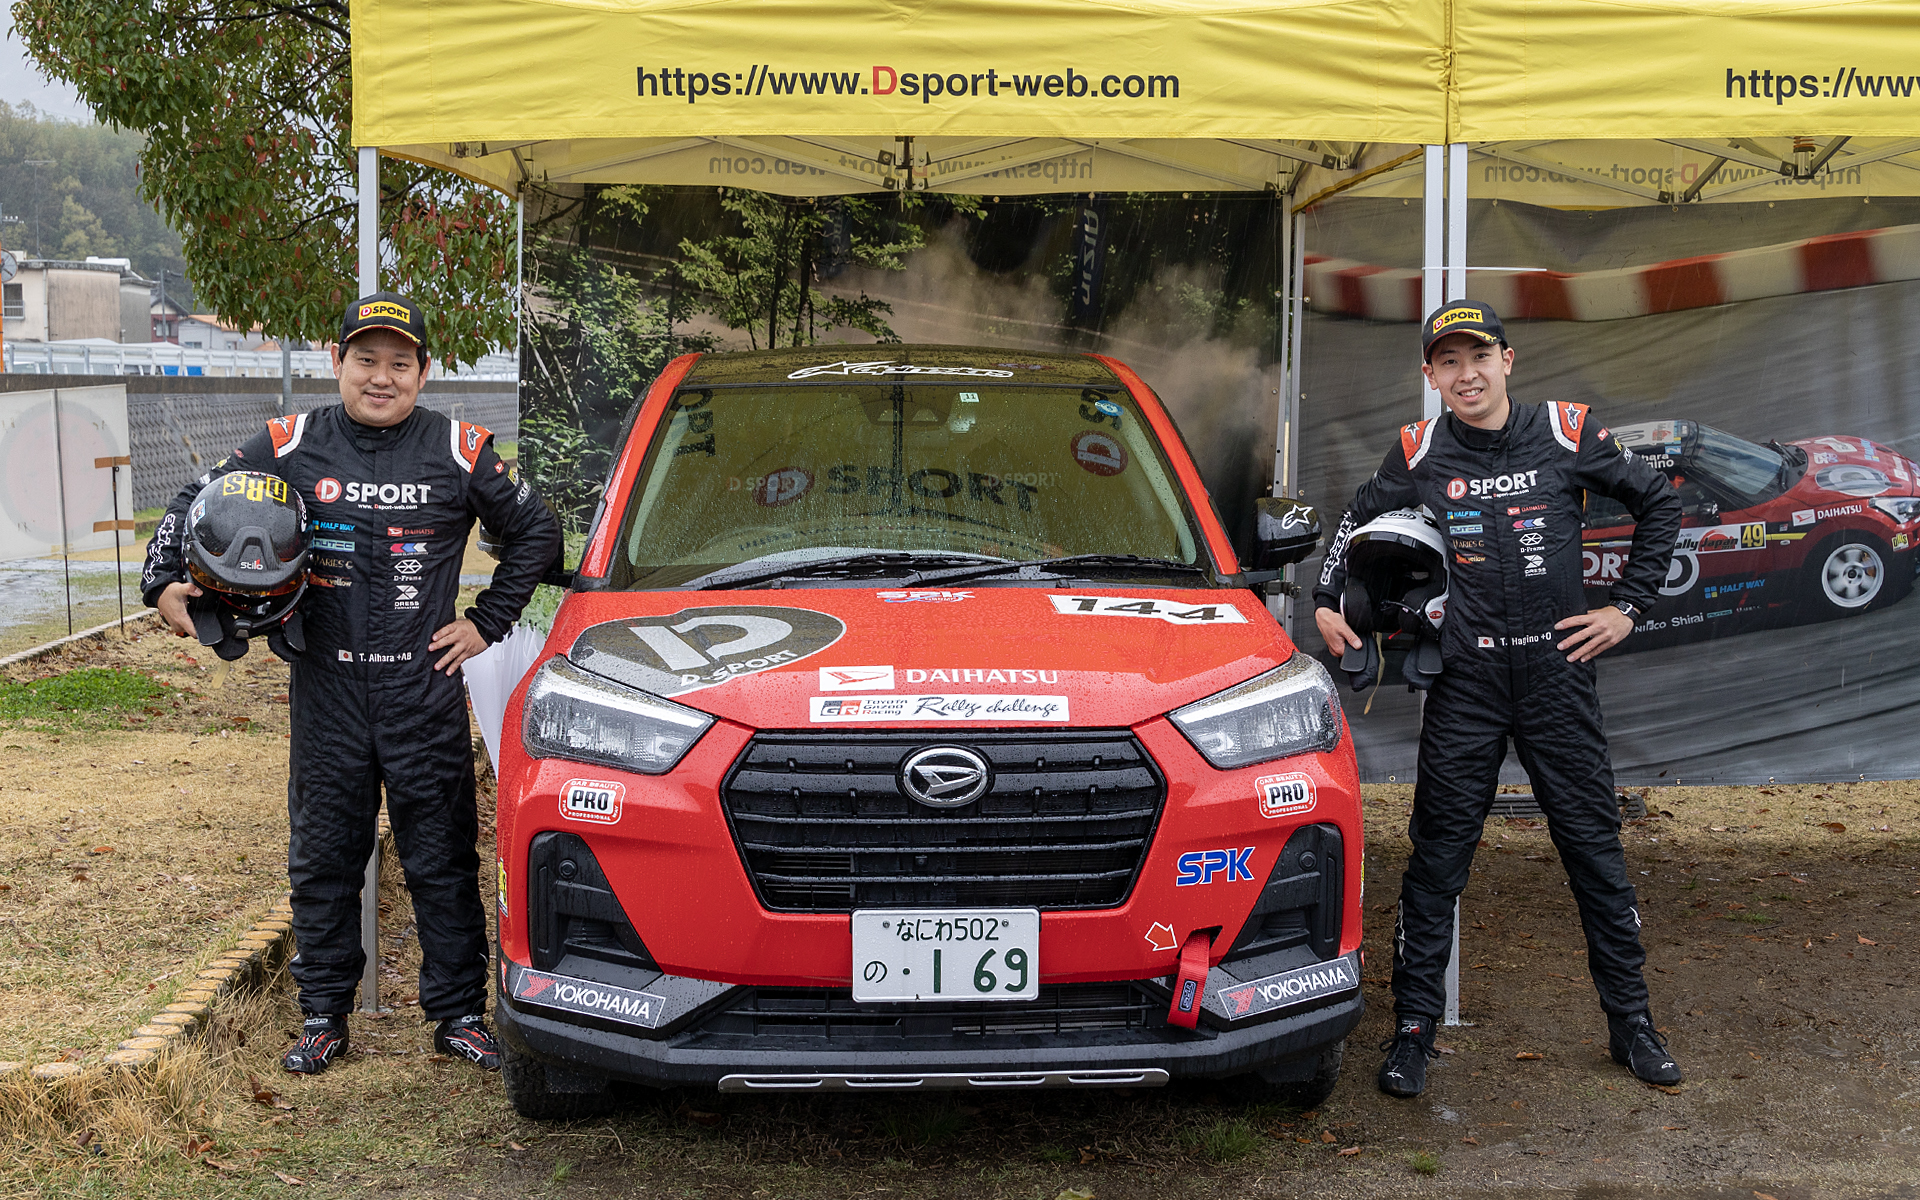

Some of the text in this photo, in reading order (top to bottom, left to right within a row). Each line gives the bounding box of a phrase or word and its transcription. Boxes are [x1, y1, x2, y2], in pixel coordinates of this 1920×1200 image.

[637, 65, 1180, 104] https://www.Dsport-web.com
[1726, 67, 1920, 105] https://ww
[373, 306, 408, 319] SPORT
[1444, 312, 1480, 323] SPORT
[345, 482, 431, 504] SPORT
[1469, 470, 1538, 495] SPORT
[1817, 504, 1862, 519] DAIHATSU
[321, 522, 339, 530] HALF
[340, 523, 356, 532] WAY
[1742, 525, 1763, 547] 49
[1701, 537, 1738, 548] Japan
[1719, 579, 1765, 594] HALF WAY
[1071, 597, 1225, 621] 144
[1671, 612, 1704, 627] Shirai
[1500, 637, 1508, 646] T.
[1512, 634, 1539, 646] Hagino
[359, 652, 367, 662] T.
[369, 653, 395, 662] Aihara
[681, 650, 798, 687] D-SPORT
[906, 668, 1058, 684] DAIHATSU
[820, 700, 862, 716] GR
[913, 697, 1060, 718] Rally challenge
[572, 790, 609, 811] PRO
[1269, 783, 1304, 804] PRO
[1176, 847, 1256, 887] SPK
[864, 961, 888, 983] の
[1257, 967, 1349, 1003] YOKOHAMA
[554, 983, 650, 1019] YOKOHAMA
